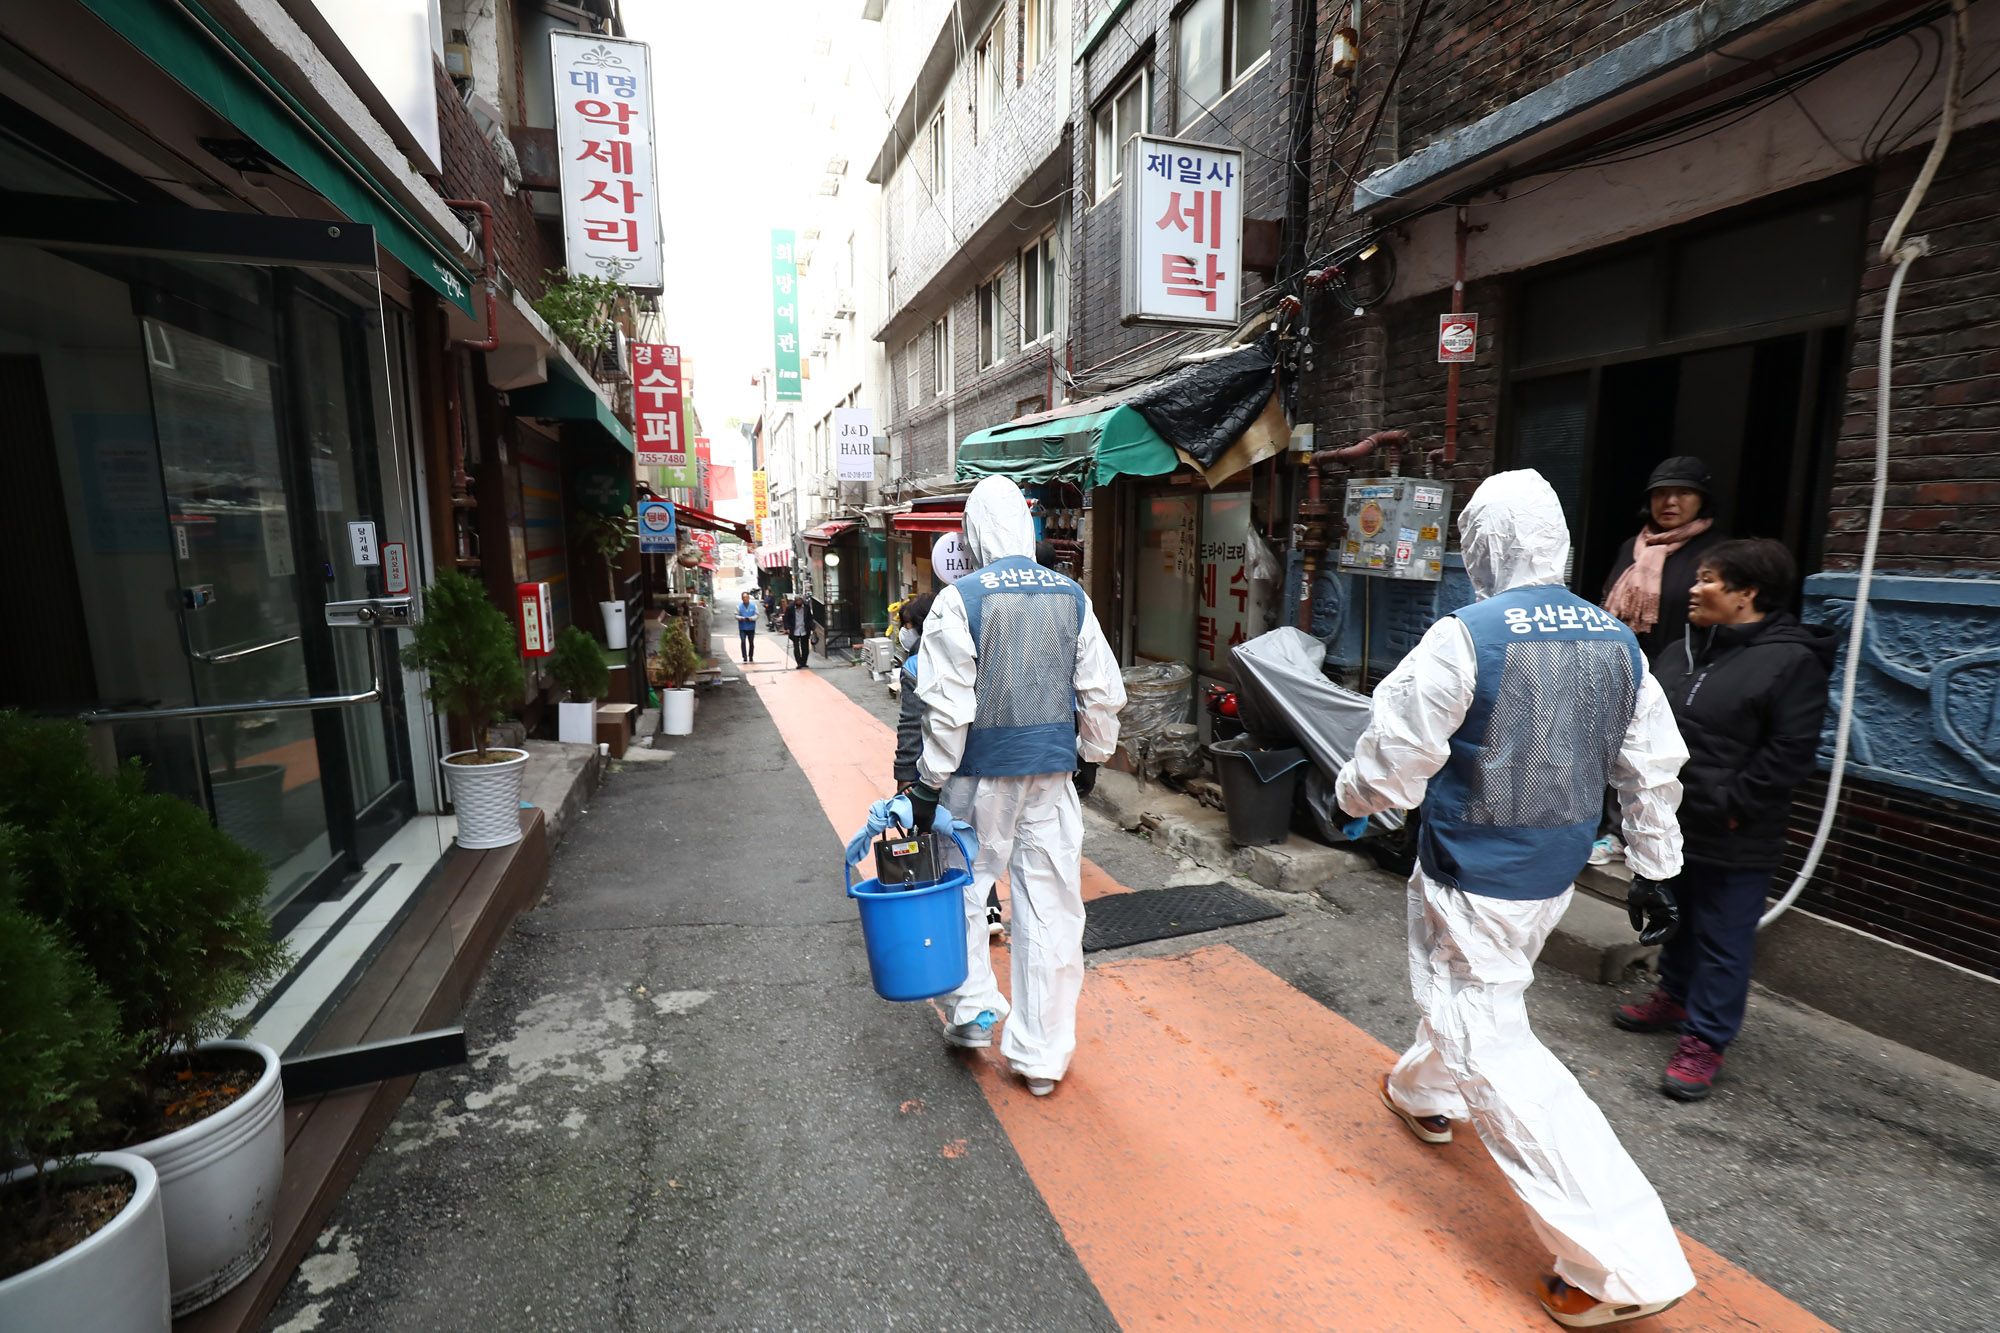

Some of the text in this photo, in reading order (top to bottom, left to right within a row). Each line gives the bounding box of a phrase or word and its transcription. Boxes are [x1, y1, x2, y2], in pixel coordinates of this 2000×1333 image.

[568, 70, 637, 98] 대명
[574, 99, 643, 252] 악세사리
[1147, 153, 1234, 187] 제일사
[1155, 190, 1225, 311] 세탁
[635, 346, 678, 366] 경월
[638, 369, 678, 450] 수퍼
[640, 453, 685, 464] 755-7480
[841, 443, 871, 455] HAIR
[647, 512, 667, 522] 담배
[357, 528, 370, 561] 당기세요
[1200, 542, 1246, 563] 드라이크리
[390, 550, 400, 579] 어서오세요
[979, 568, 1072, 589] 용산보건소
[1199, 564, 1218, 661] 세탁
[1504, 604, 1622, 634] 용산보건소
